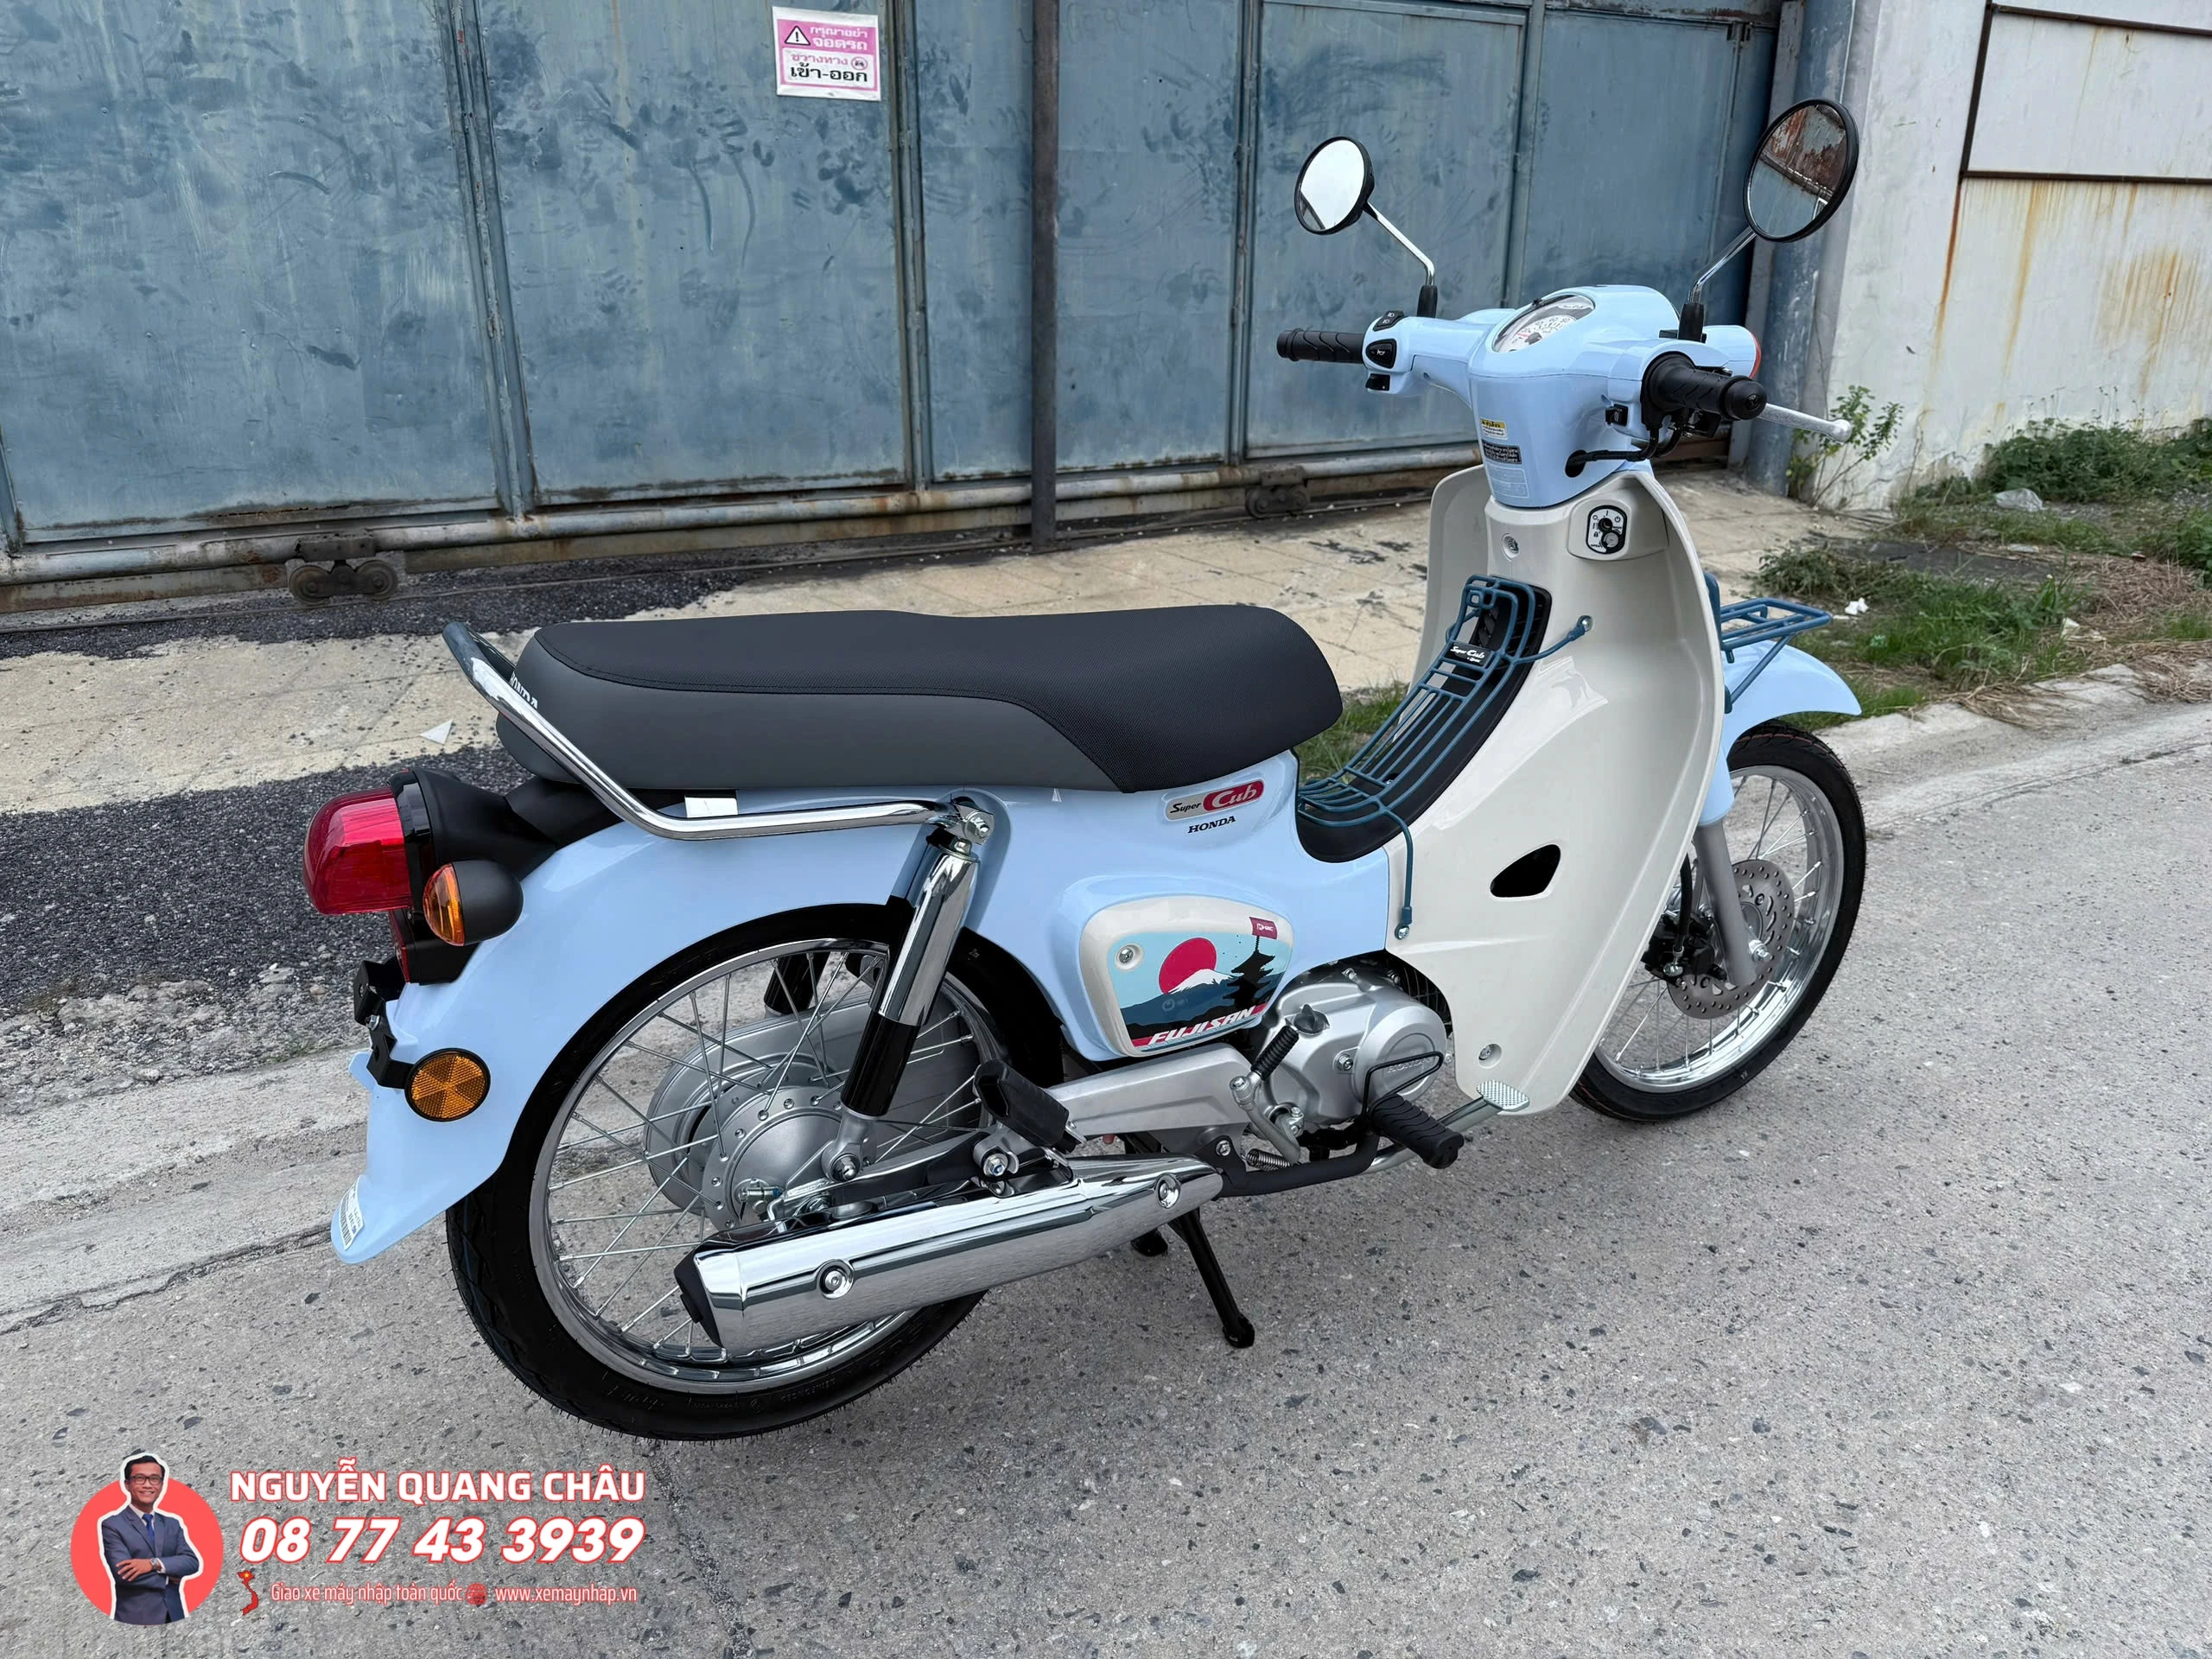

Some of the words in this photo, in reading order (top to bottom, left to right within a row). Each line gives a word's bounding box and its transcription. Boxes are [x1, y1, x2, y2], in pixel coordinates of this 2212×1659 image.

[810, 26, 868, 38] กรุณาอย่า
[812, 37, 868, 51] จอดรถ
[791, 54, 849, 66] ขวางทาง
[790, 61, 868, 82] เข้า-ออก
[1169, 802, 1202, 814] Super
[1211, 784, 1257, 809] Cub
[1187, 815, 1236, 834] HONDA
[1147, 1005, 1256, 1046] FUJISAN
